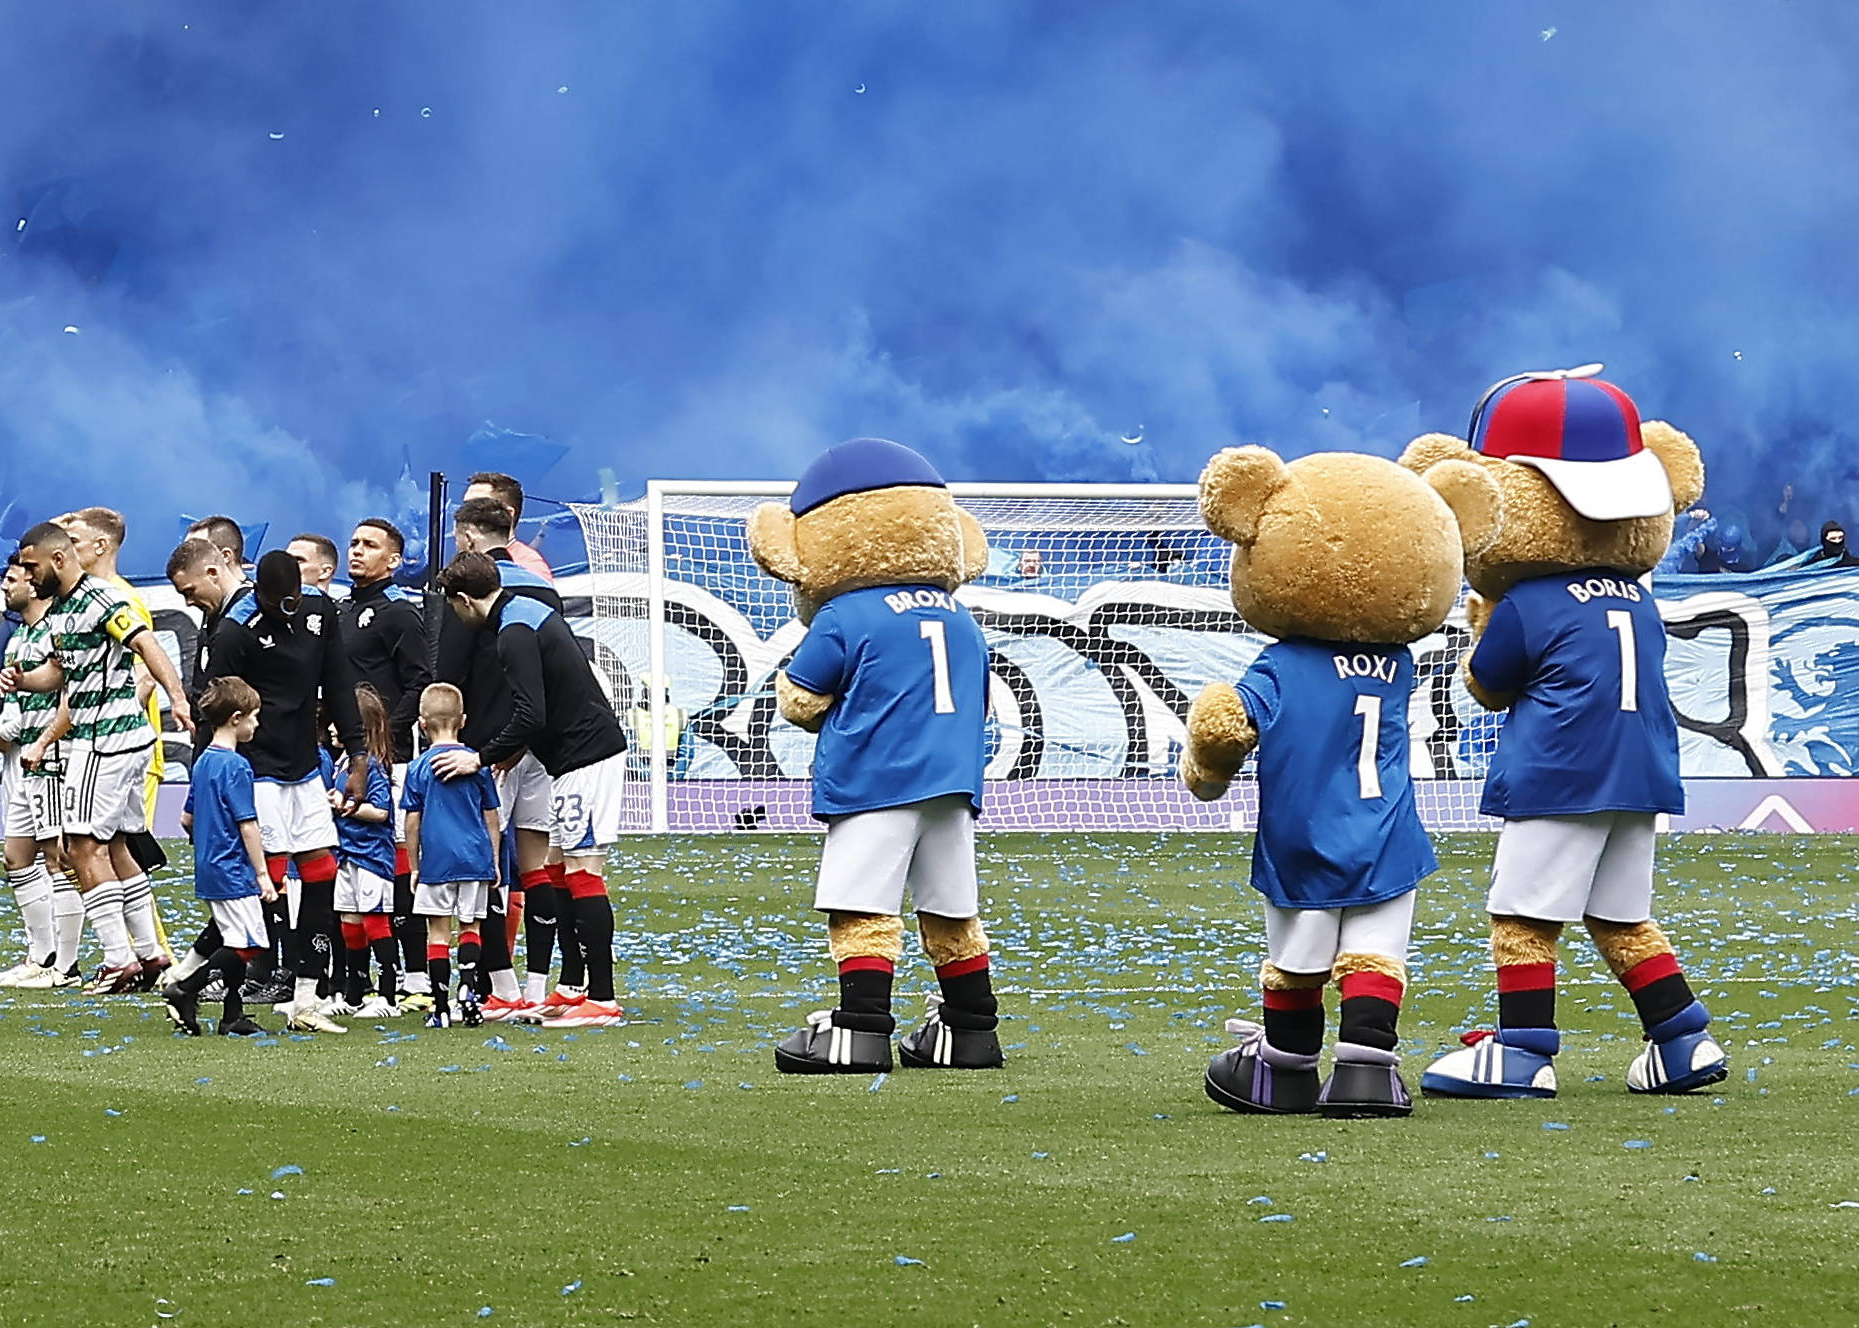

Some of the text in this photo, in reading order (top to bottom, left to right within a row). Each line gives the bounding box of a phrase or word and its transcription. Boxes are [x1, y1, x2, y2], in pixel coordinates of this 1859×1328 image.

[884, 590, 957, 614] BROXI
[1567, 578, 1642, 604] BORIS
[114, 614, 131, 632] C
[920, 620, 956, 714] 1
[1333, 653, 1397, 684] ROXI
[1606, 610, 1638, 712] 1
[1354, 694, 1382, 799] 1
[554, 794, 584, 823] 23
